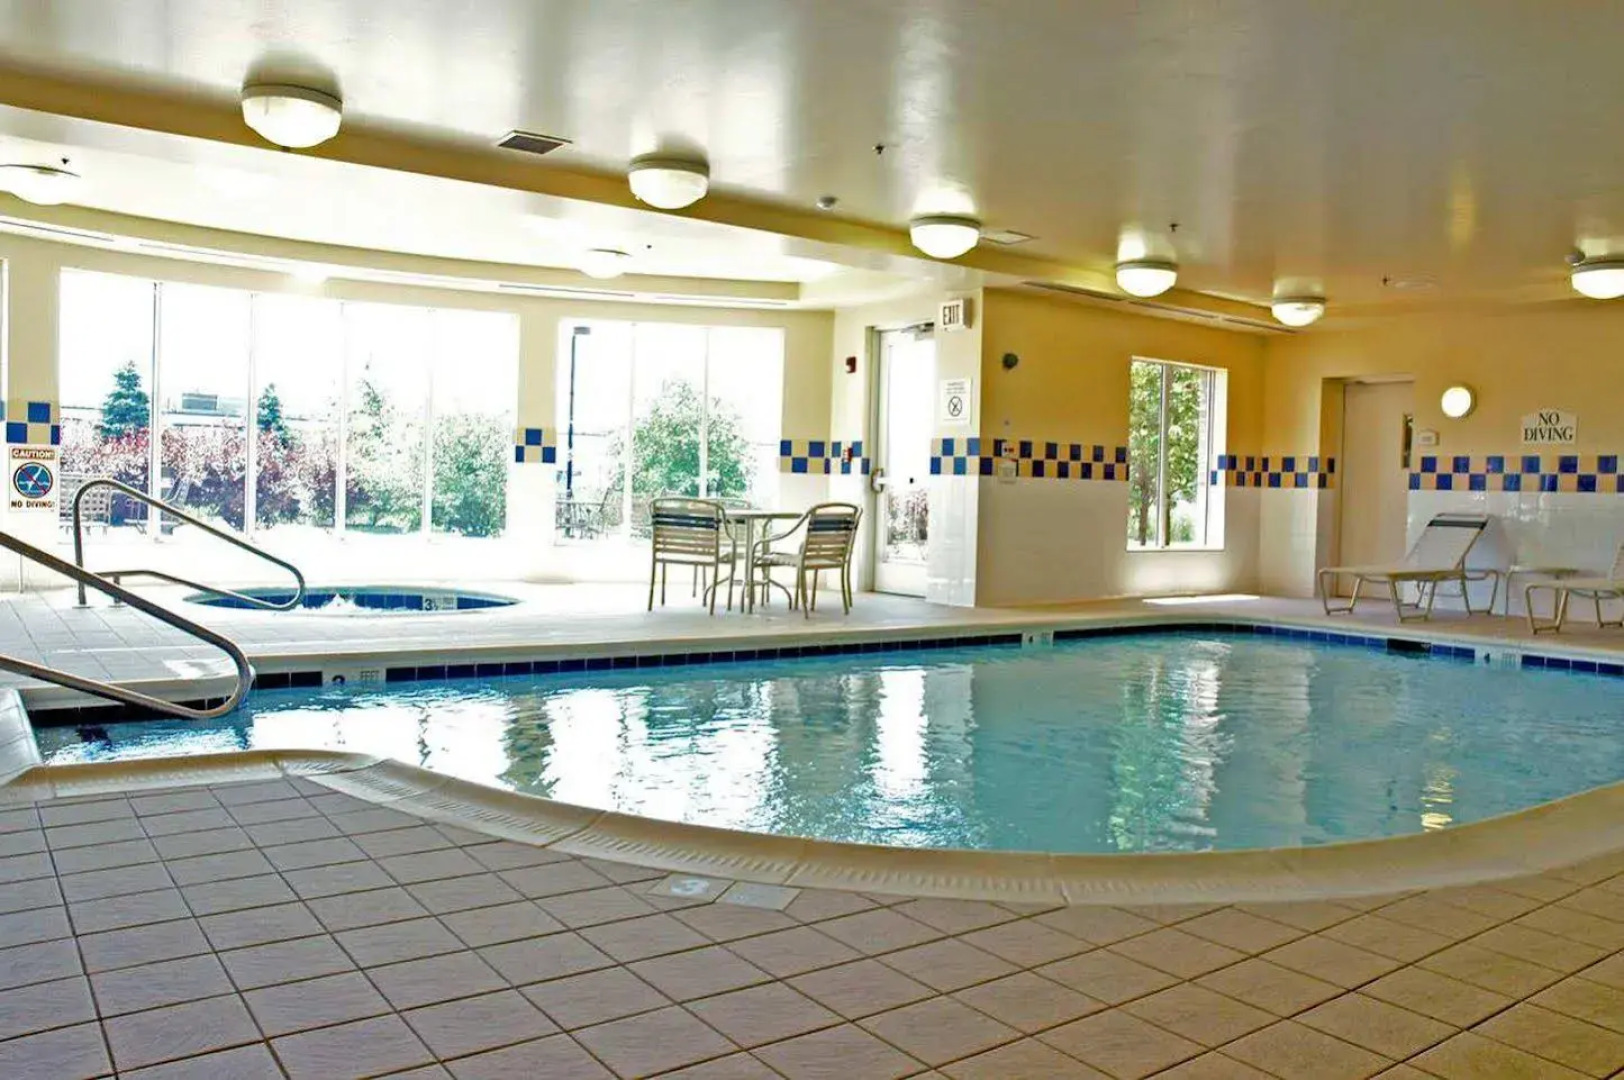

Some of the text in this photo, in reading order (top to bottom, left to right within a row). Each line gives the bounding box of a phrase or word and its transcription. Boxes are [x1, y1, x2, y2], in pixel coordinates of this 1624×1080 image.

[943, 304, 960, 325] EXIT
[1538, 412, 1560, 427] NO
[1524, 427, 1573, 441] DIVING
